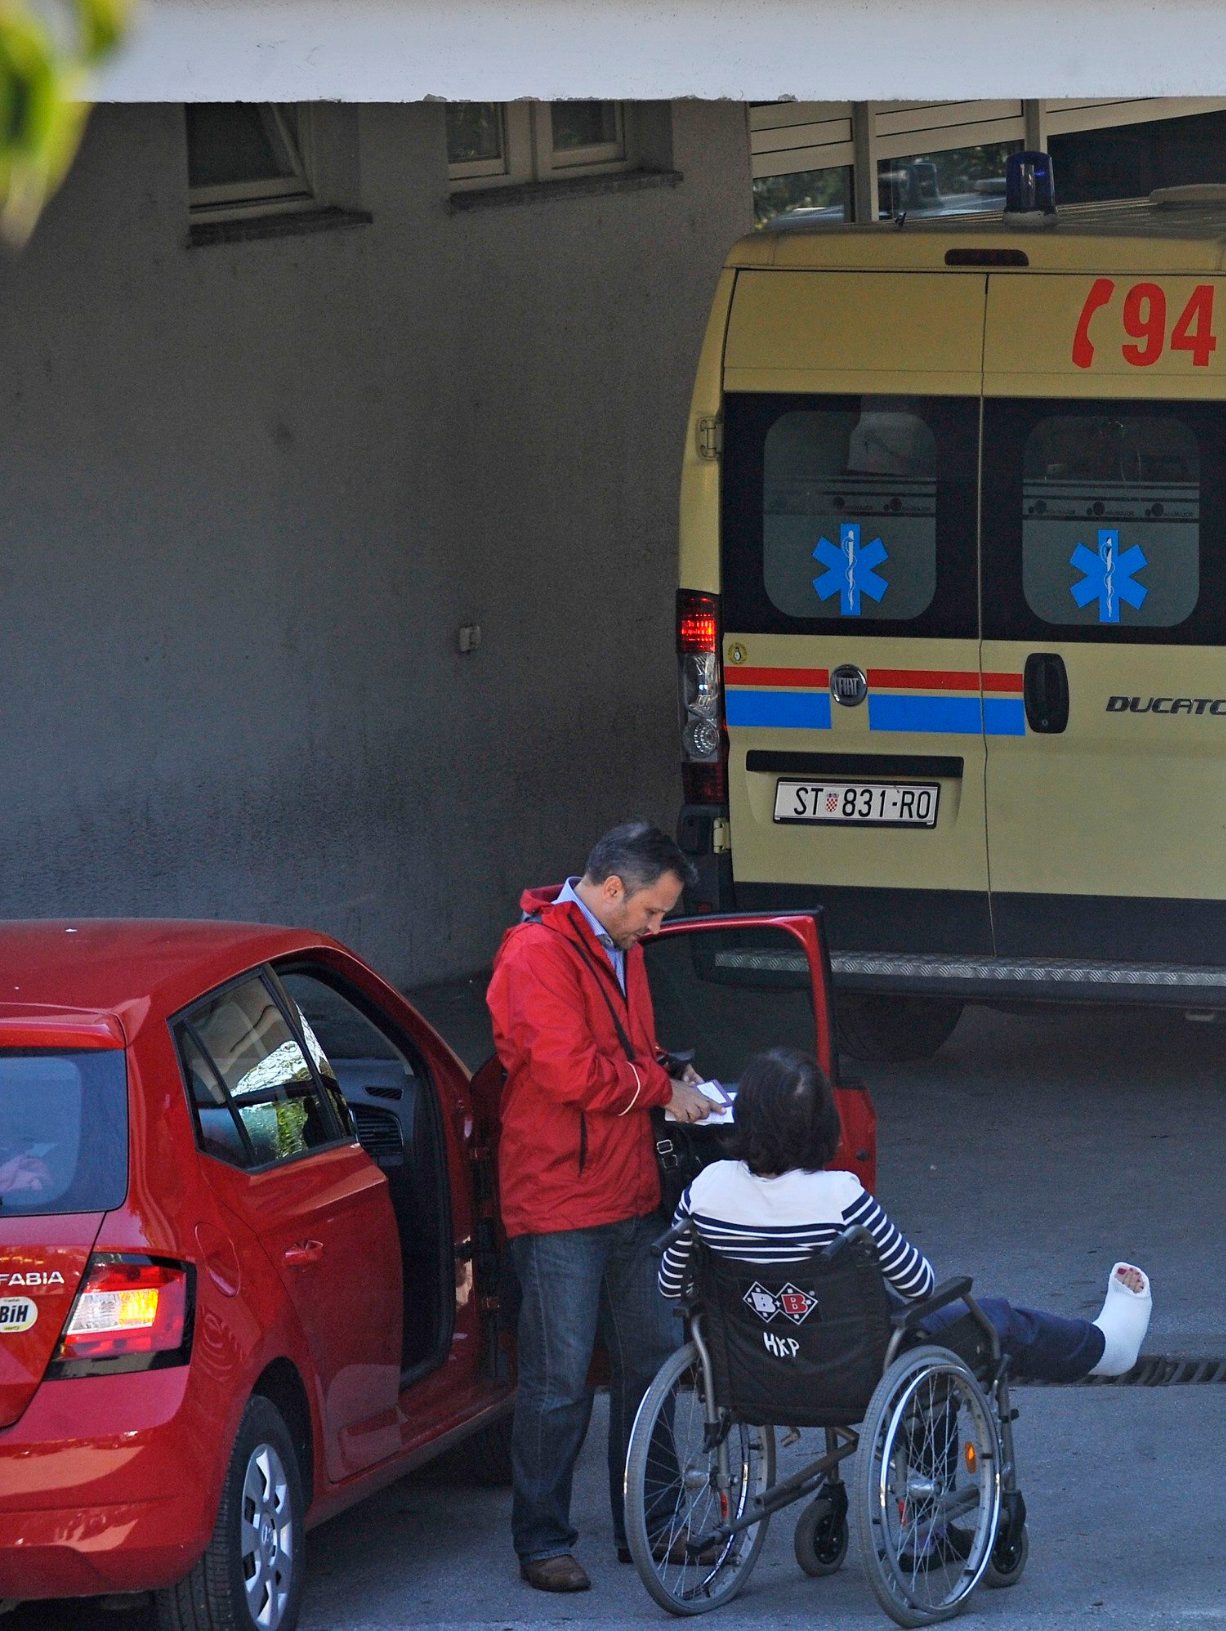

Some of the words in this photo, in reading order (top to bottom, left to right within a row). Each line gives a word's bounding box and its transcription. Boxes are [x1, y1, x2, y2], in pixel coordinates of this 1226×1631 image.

[1121, 282, 1217, 367] 94
[839, 677, 859, 696] FIAT
[793, 786, 824, 816] ST
[842, 788, 931, 819] 831-RO
[0, 1271, 65, 1286] FABIA
[763, 1331, 800, 1358] HKP
